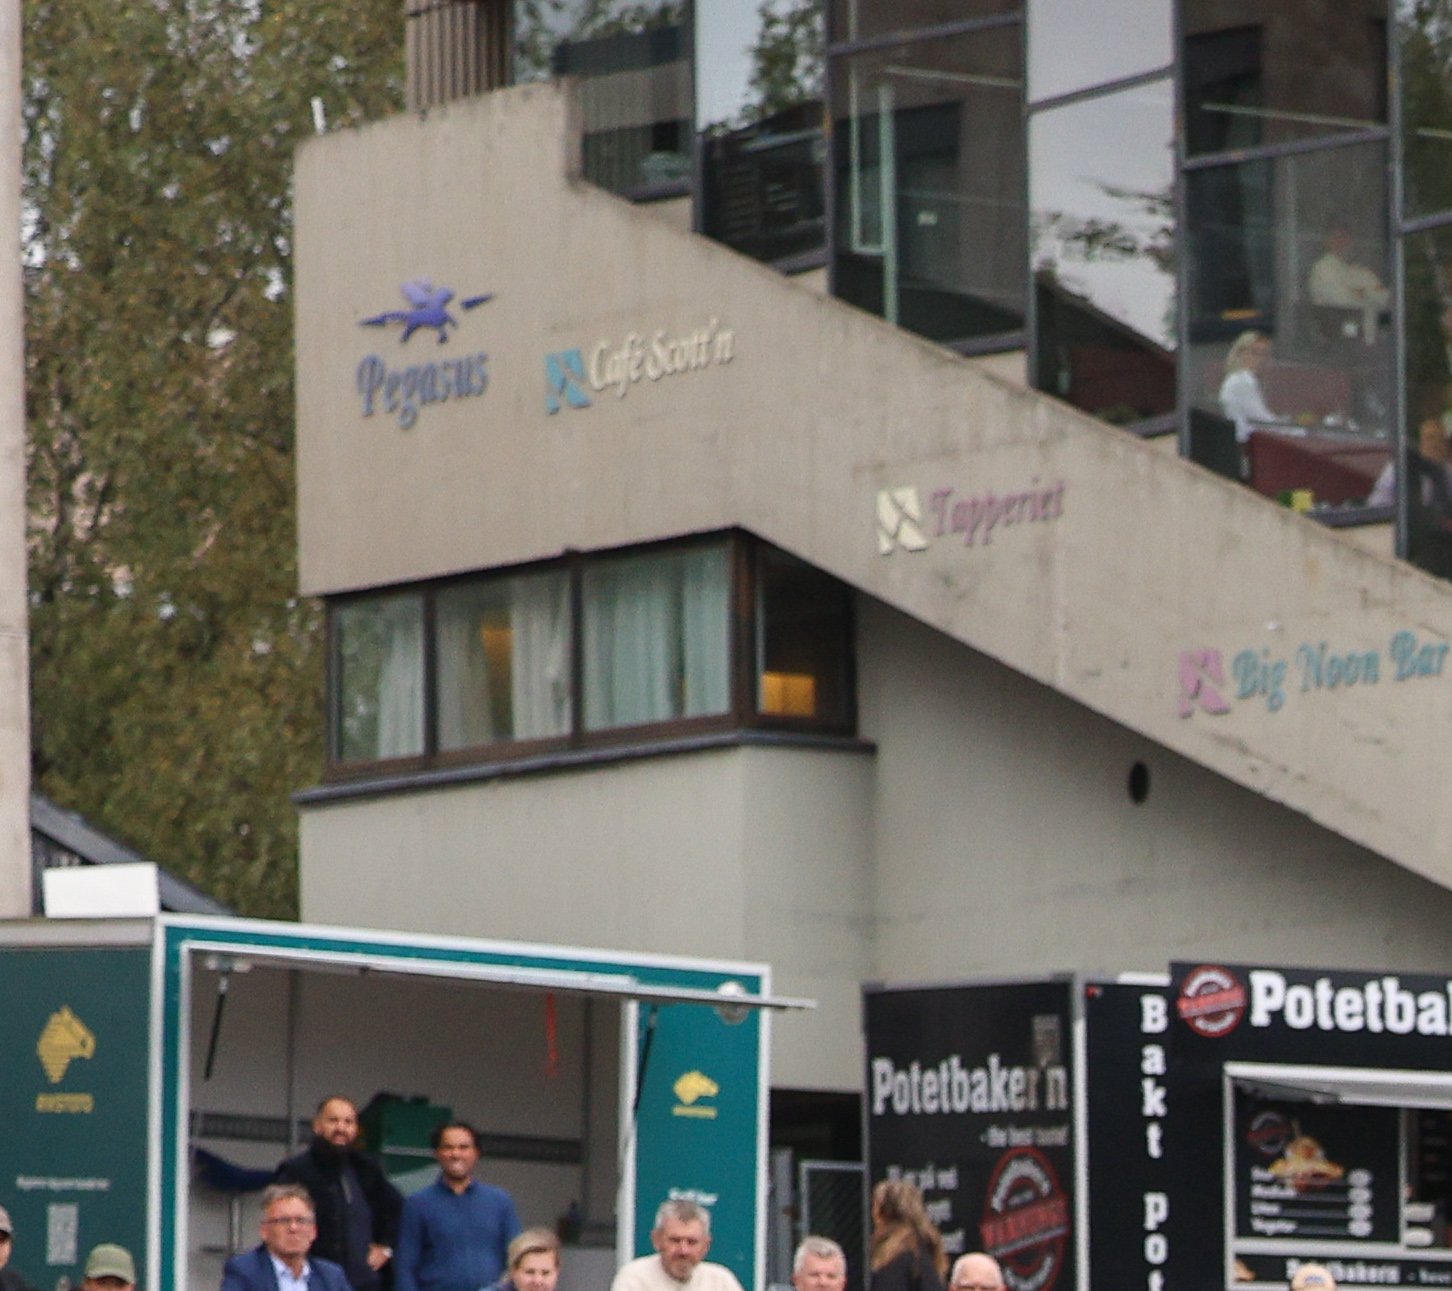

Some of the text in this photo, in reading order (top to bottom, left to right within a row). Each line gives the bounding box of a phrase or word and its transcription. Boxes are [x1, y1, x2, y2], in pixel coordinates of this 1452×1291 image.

[357, 353, 489, 429] Pegasus
[590, 332, 642, 398] Café
[930, 480, 1064, 548] Tapperiet
[1233, 631, 1449, 711] Big Noon Bar
[1140, 994, 1168, 1159] Bakt
